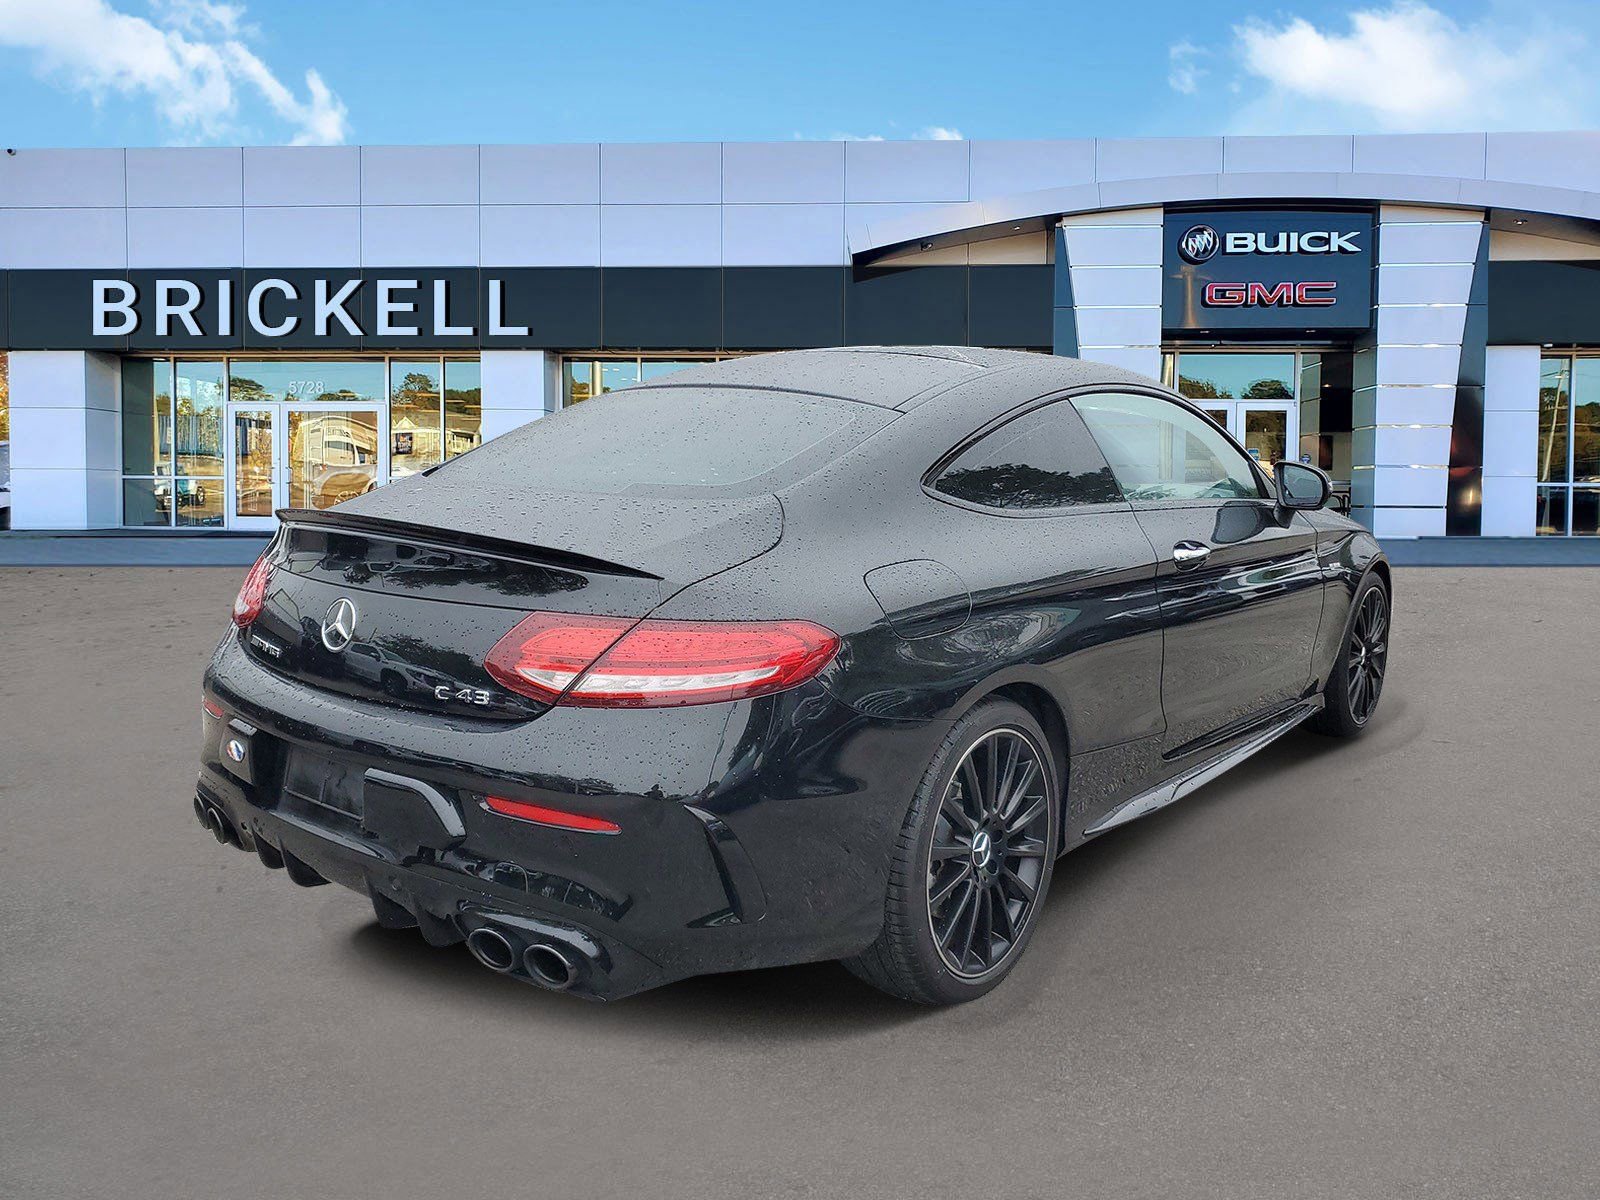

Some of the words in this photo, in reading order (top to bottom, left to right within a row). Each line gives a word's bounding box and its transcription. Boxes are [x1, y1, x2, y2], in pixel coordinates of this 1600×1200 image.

[1225, 231, 1362, 253] BUICK
[1205, 281, 1337, 305] GMC
[92, 278, 531, 337] BRICKELL
[288, 380, 325, 394] 5728
[434, 685, 450, 700] C
[455, 689, 490, 705] 43
